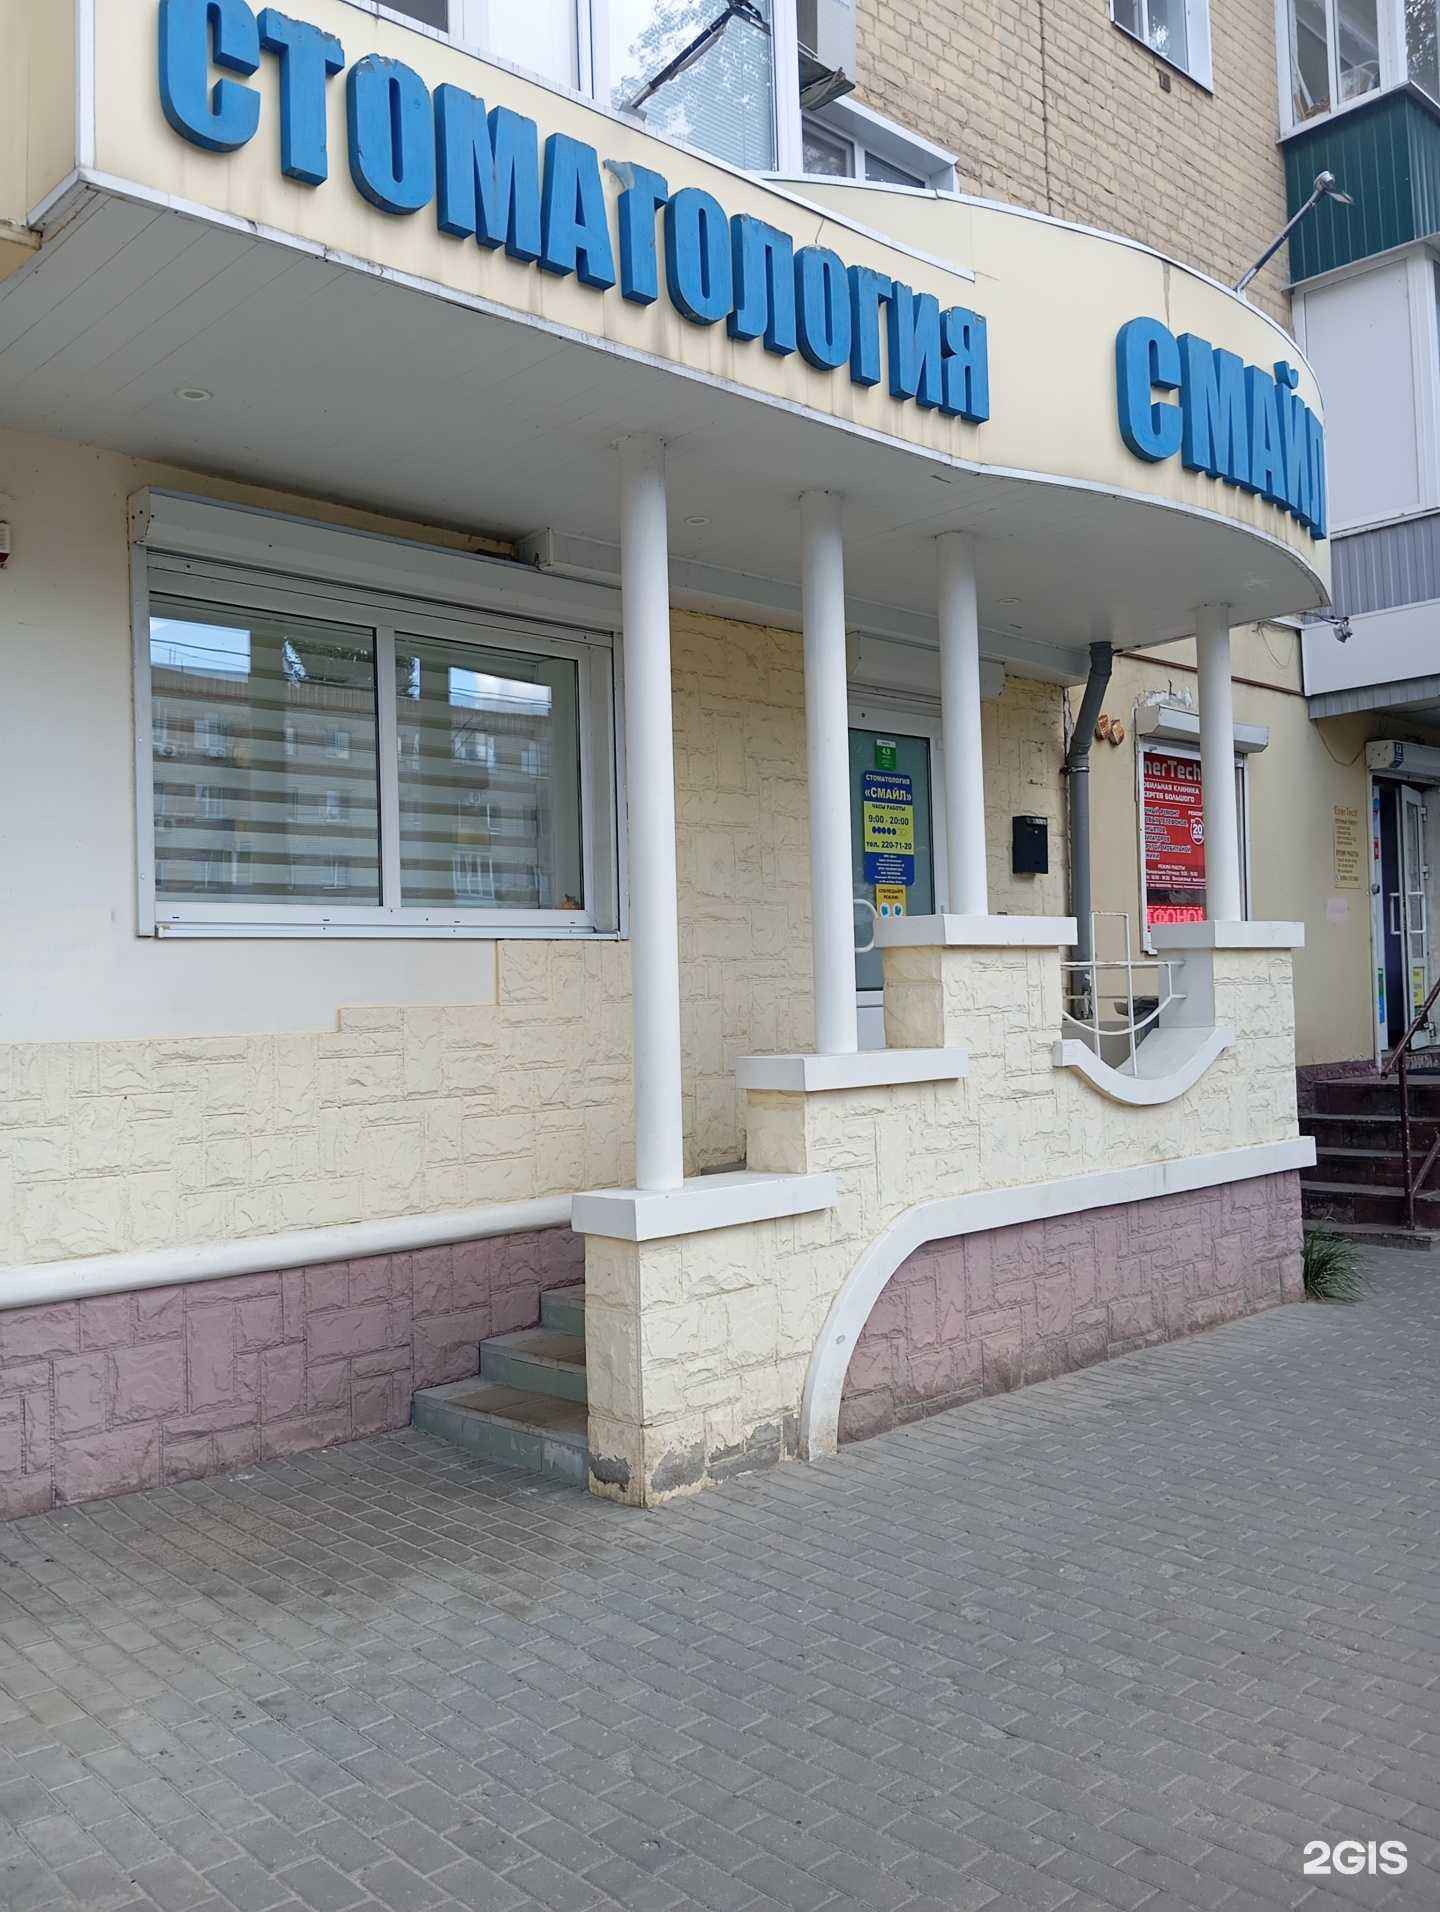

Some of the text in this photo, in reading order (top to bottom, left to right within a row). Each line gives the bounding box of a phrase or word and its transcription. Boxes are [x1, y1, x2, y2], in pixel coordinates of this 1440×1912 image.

[158, 0, 989, 425] СТОМАТОЛОГИЯ
[865, 774, 910, 784] СТОМАТОЛОГИЯ
[864, 787, 912, 801] «СМАЙЛ»
[868, 814, 884, 824] 9:00
[889, 815, 909, 826] 20:00
[880, 840, 913, 850] 220-71-20
